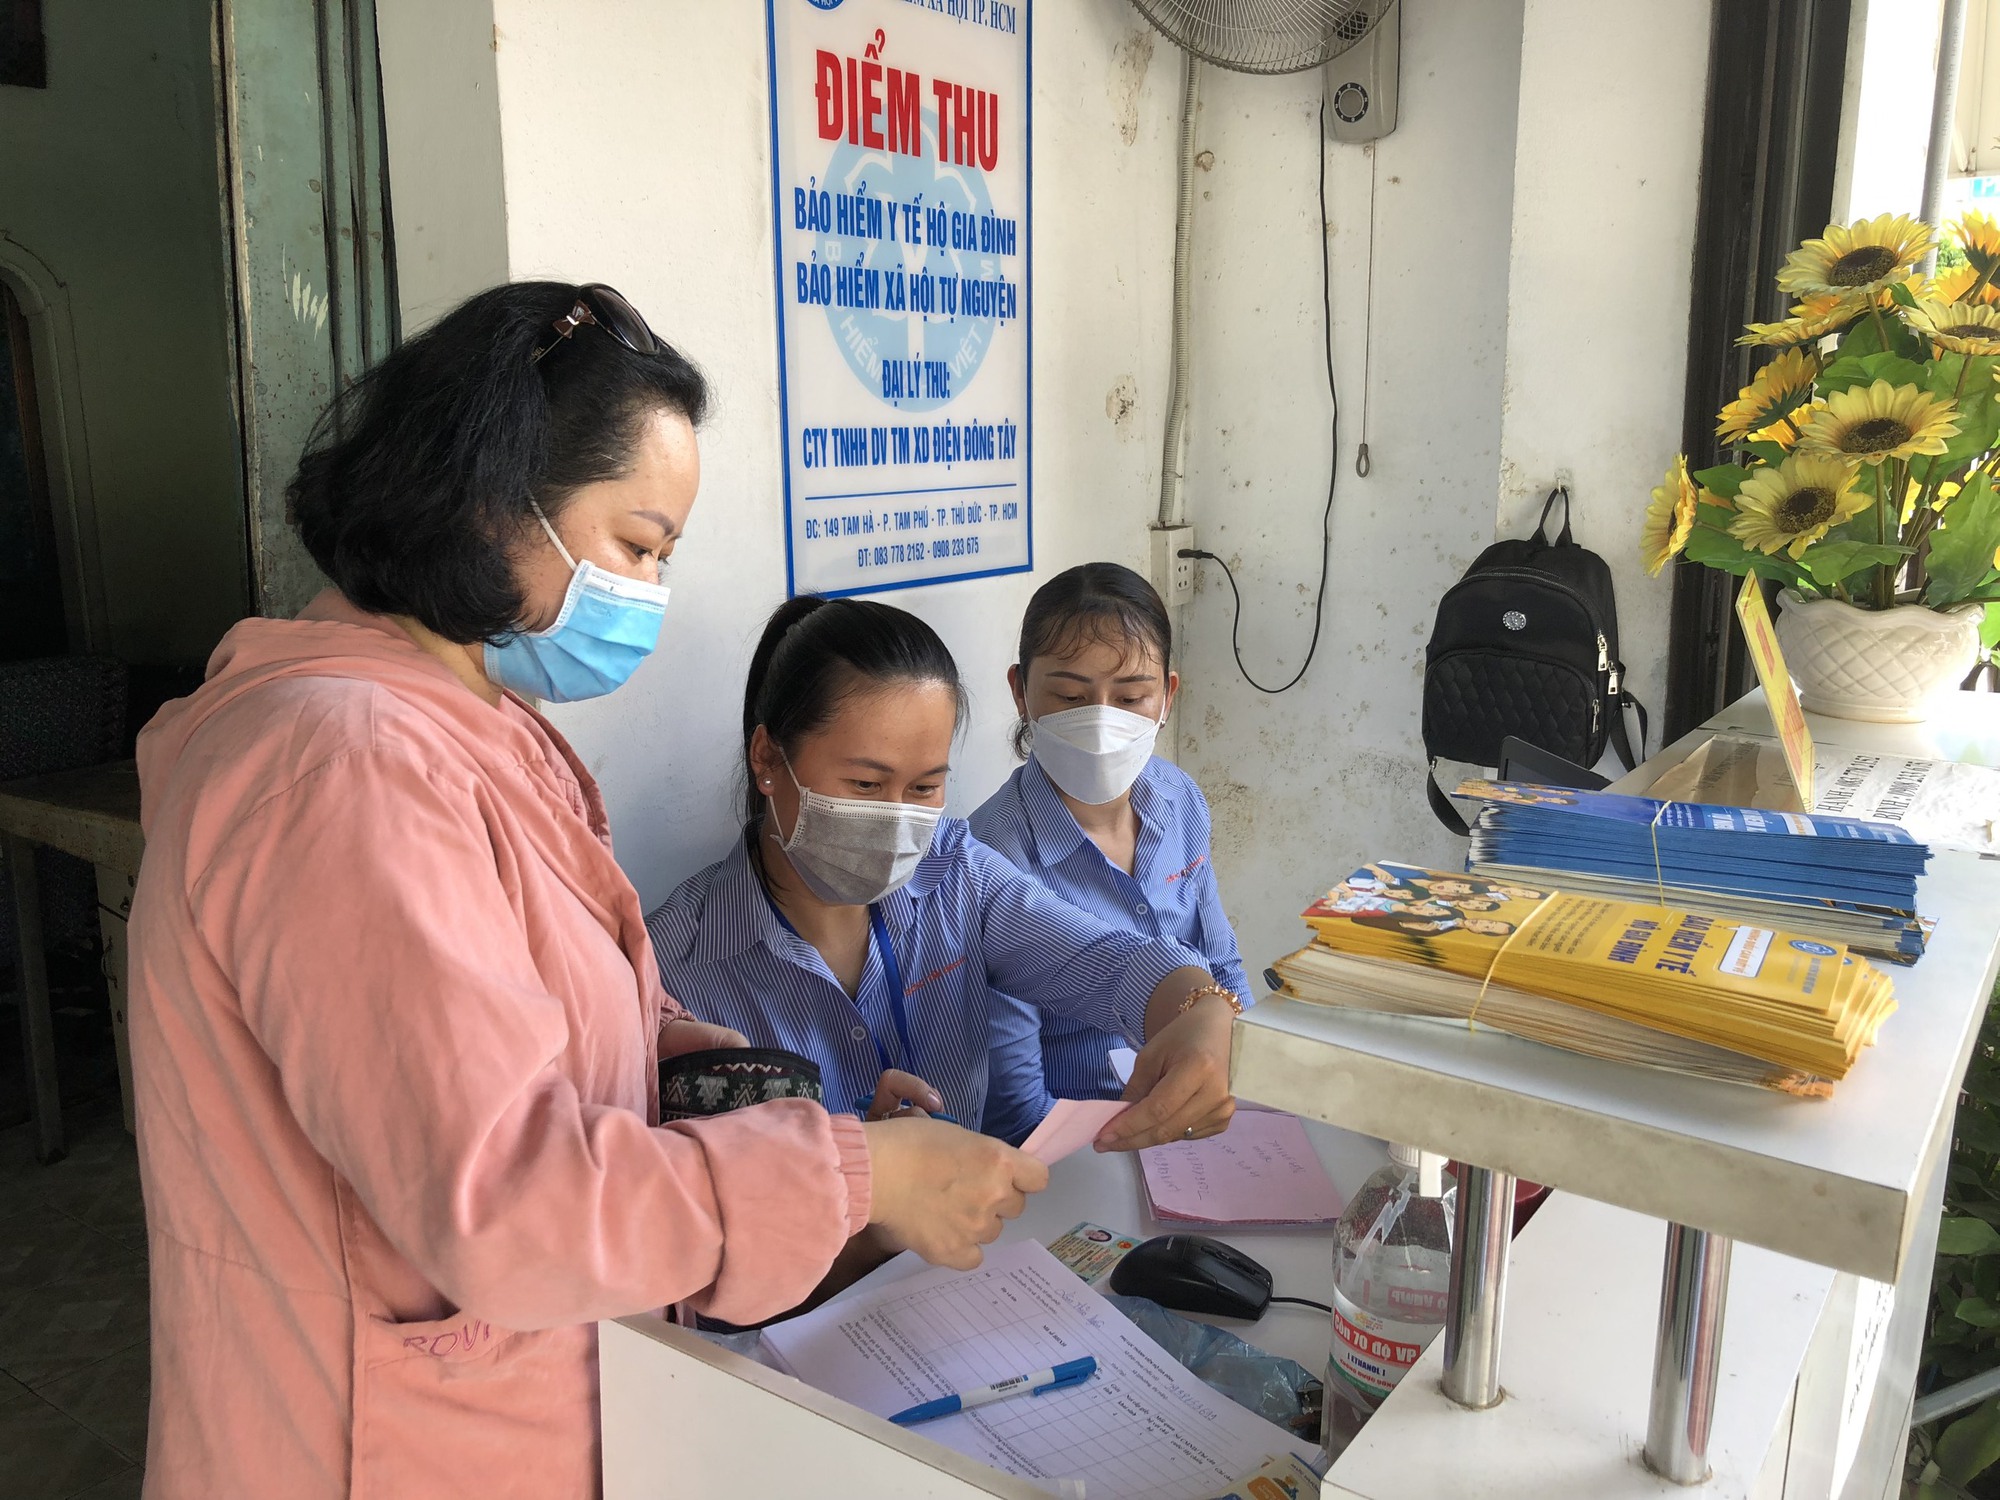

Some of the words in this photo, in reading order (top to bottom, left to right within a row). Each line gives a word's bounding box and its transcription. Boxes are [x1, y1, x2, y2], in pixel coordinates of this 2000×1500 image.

[990, 4, 1017, 34] HCM
[815, 28, 921, 158] ĐIỂM
[933, 79, 998, 172] THU
[794, 176, 832, 233] BẢO
[836, 180, 882, 240] HIỂM
[887, 201, 898, 242] Y
[903, 193, 923, 245] TẾ
[926, 201, 947, 256] HỘ
[952, 211, 978, 252] GIA
[981, 212, 1016, 256] ĐÌNH
[796, 250, 831, 306] BẢO
[836, 252, 880, 310] HIỂM
[885, 263, 906, 311] XÃ
[910, 266, 935, 321] HỘI
[939, 272, 958, 324] TỰ
[961, 275, 1016, 327] NGUYỆN
[882, 359, 903, 407] ĐẠI
[907, 352, 921, 399] LÝ
[924, 361, 950, 399] THU:
[803, 427, 828, 469] CTY
[832, 427, 868, 467] TNHH
[871, 427, 887, 466] DV
[891, 426, 910, 464] TM
[914, 425, 930, 464] XD
[933, 418, 960, 470] ĐIỆN
[964, 418, 994, 462] ĐÔNG
[997, 418, 1016, 460] TÂY
[806, 519, 821, 539] ĐC:
[824, 517, 839, 538] 149
[842, 516, 860, 535] TAM
[862, 510, 874, 533] HÀ
[883, 512, 891, 532] P.
[894, 511, 911, 531] TAM
[913, 505, 929, 529] PHÚ
[937, 509, 949, 527] TP.
[951, 501, 965, 526] THỦ
[967, 502, 982, 524] ĐỨC
[989, 504, 1000, 522] TP.
[1002, 502, 1018, 520] HCM
[858, 548, 871, 568] ĐT:
[874, 546, 888, 565] 083
[891, 544, 905, 564] 778
[907, 541, 925, 562] 2152
[932, 540, 950, 559] 0908
[952, 538, 965, 557] 233
[966, 536, 979, 555] 675
[1815, 789, 1853, 812] HẠNH
[1620, 929, 1652, 942] GIA
[1624, 919, 1662, 931] HỘ
[1680, 914, 1728, 931] BẢO
[1607, 940, 1647, 964] ĐÌNH
[1663, 950, 1694, 960] Y
[1667, 928, 1713, 952] HIỂM
[1655, 958, 1697, 977] TẾ
[1334, 1313, 1350, 1341] Cồn
[1353, 1331, 1368, 1350] 70
[1372, 1341, 1391, 1360] độ
[1396, 1347, 1416, 1363] VP
